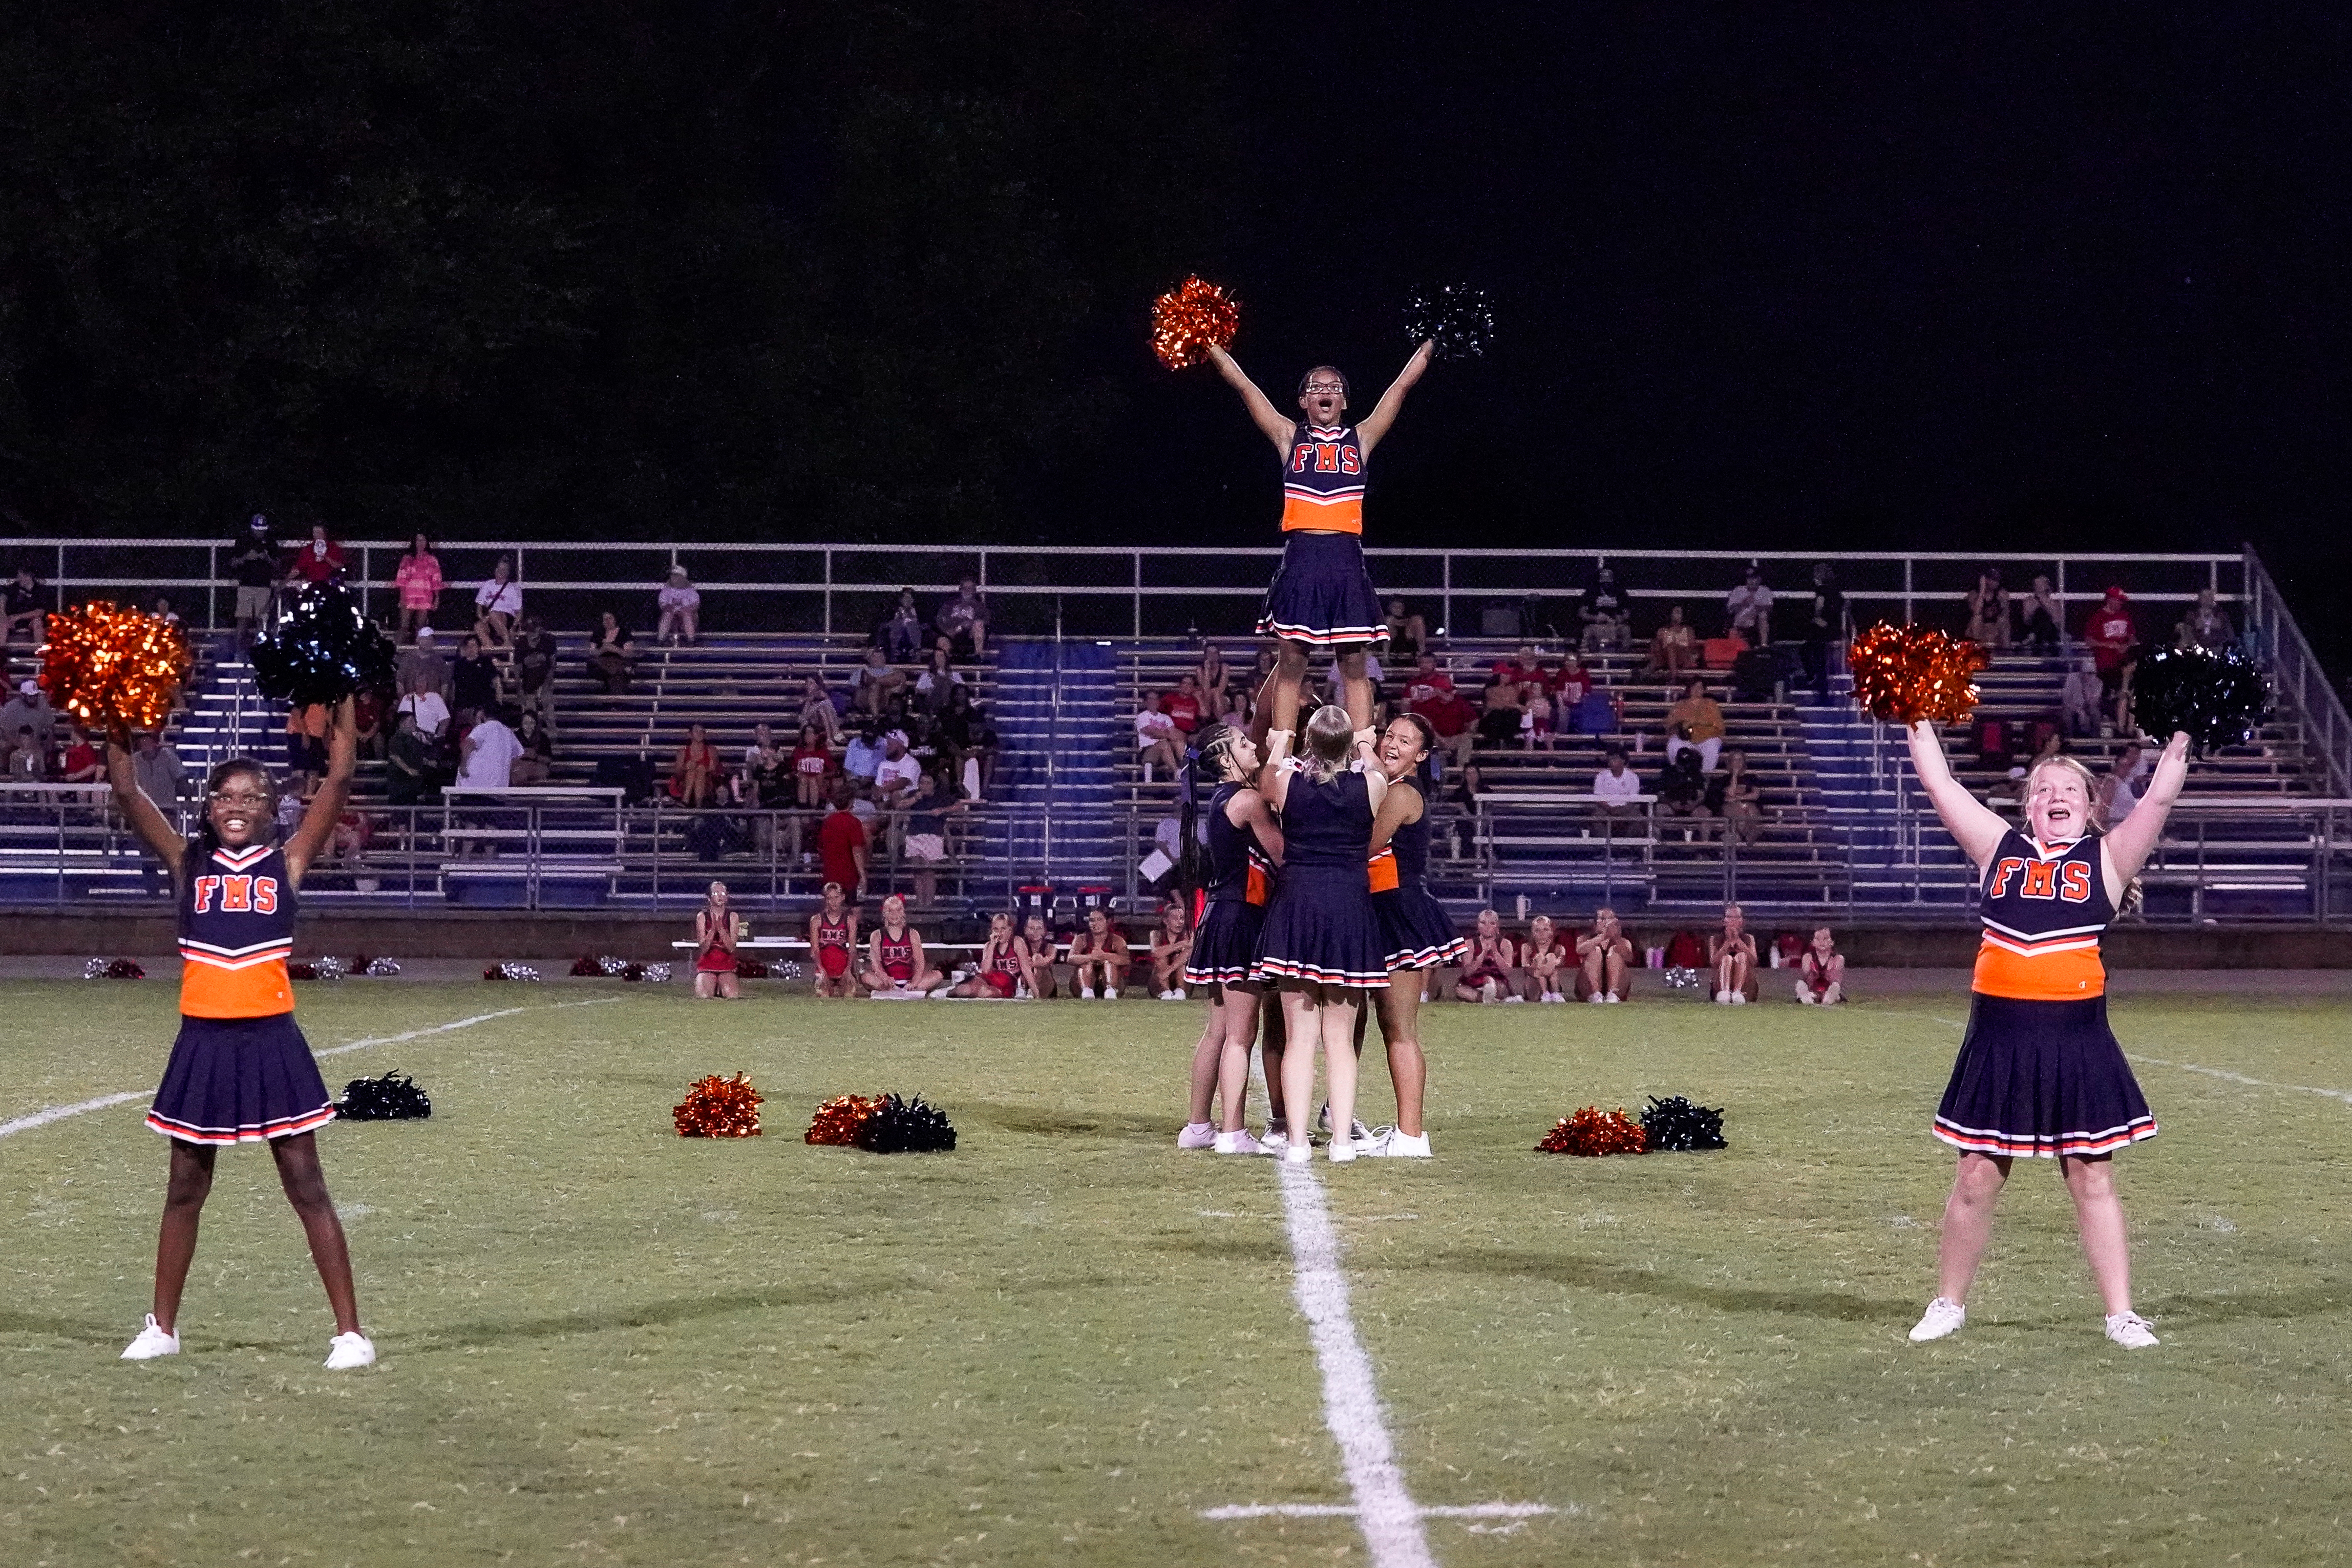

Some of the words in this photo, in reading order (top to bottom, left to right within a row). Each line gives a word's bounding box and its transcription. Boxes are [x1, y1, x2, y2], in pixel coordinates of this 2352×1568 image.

[1292, 442, 1360, 475] FMS
[195, 874, 278, 915] FMS
[1990, 857, 2091, 903] FMS
